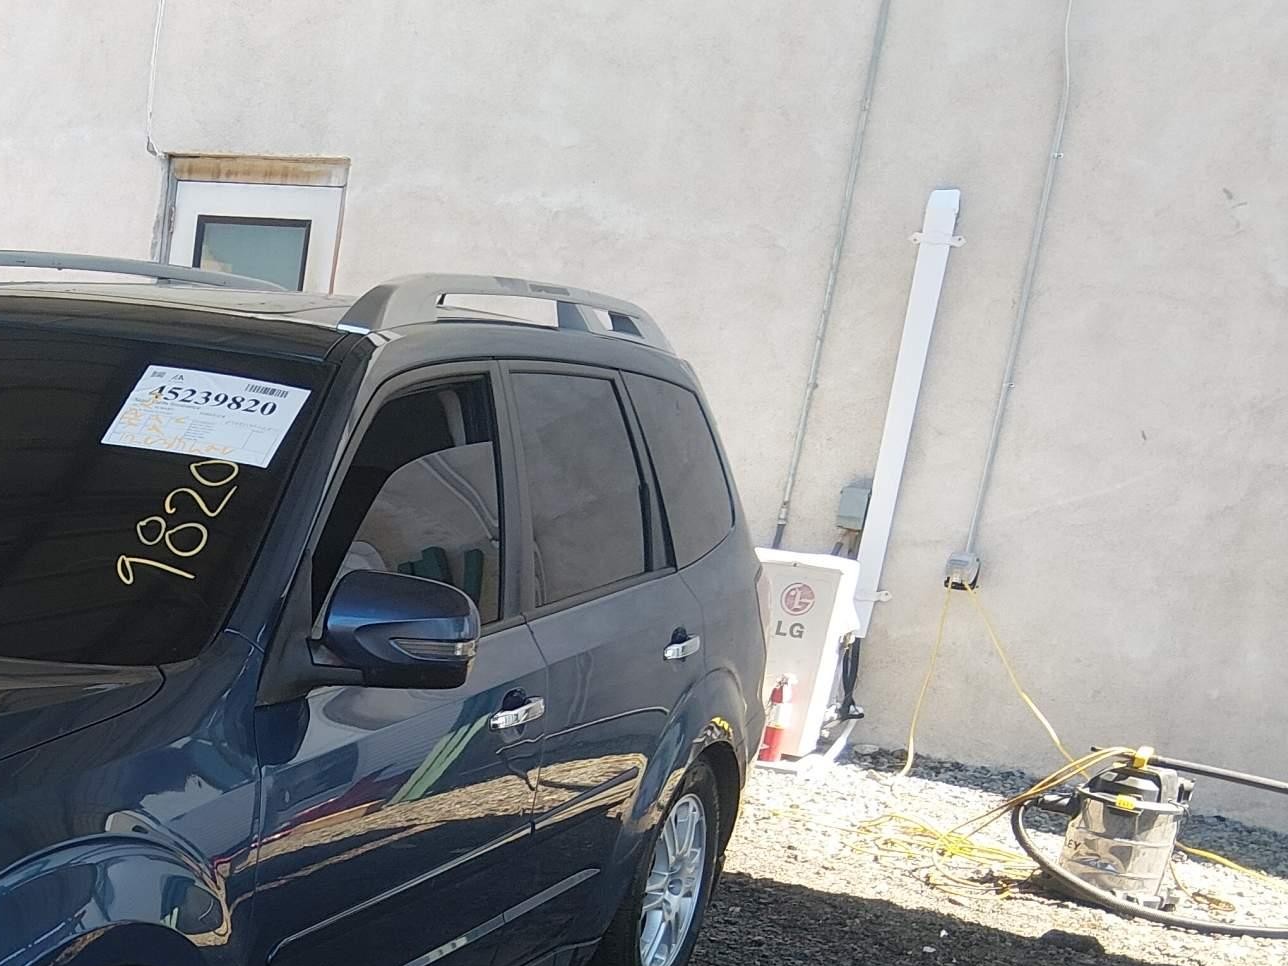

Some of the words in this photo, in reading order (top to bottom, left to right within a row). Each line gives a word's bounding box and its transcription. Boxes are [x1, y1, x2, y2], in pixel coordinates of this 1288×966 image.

[149, 385, 278, 416] 45239820
[117, 459, 239, 585] 9820
[775, 620, 805, 639] LG
